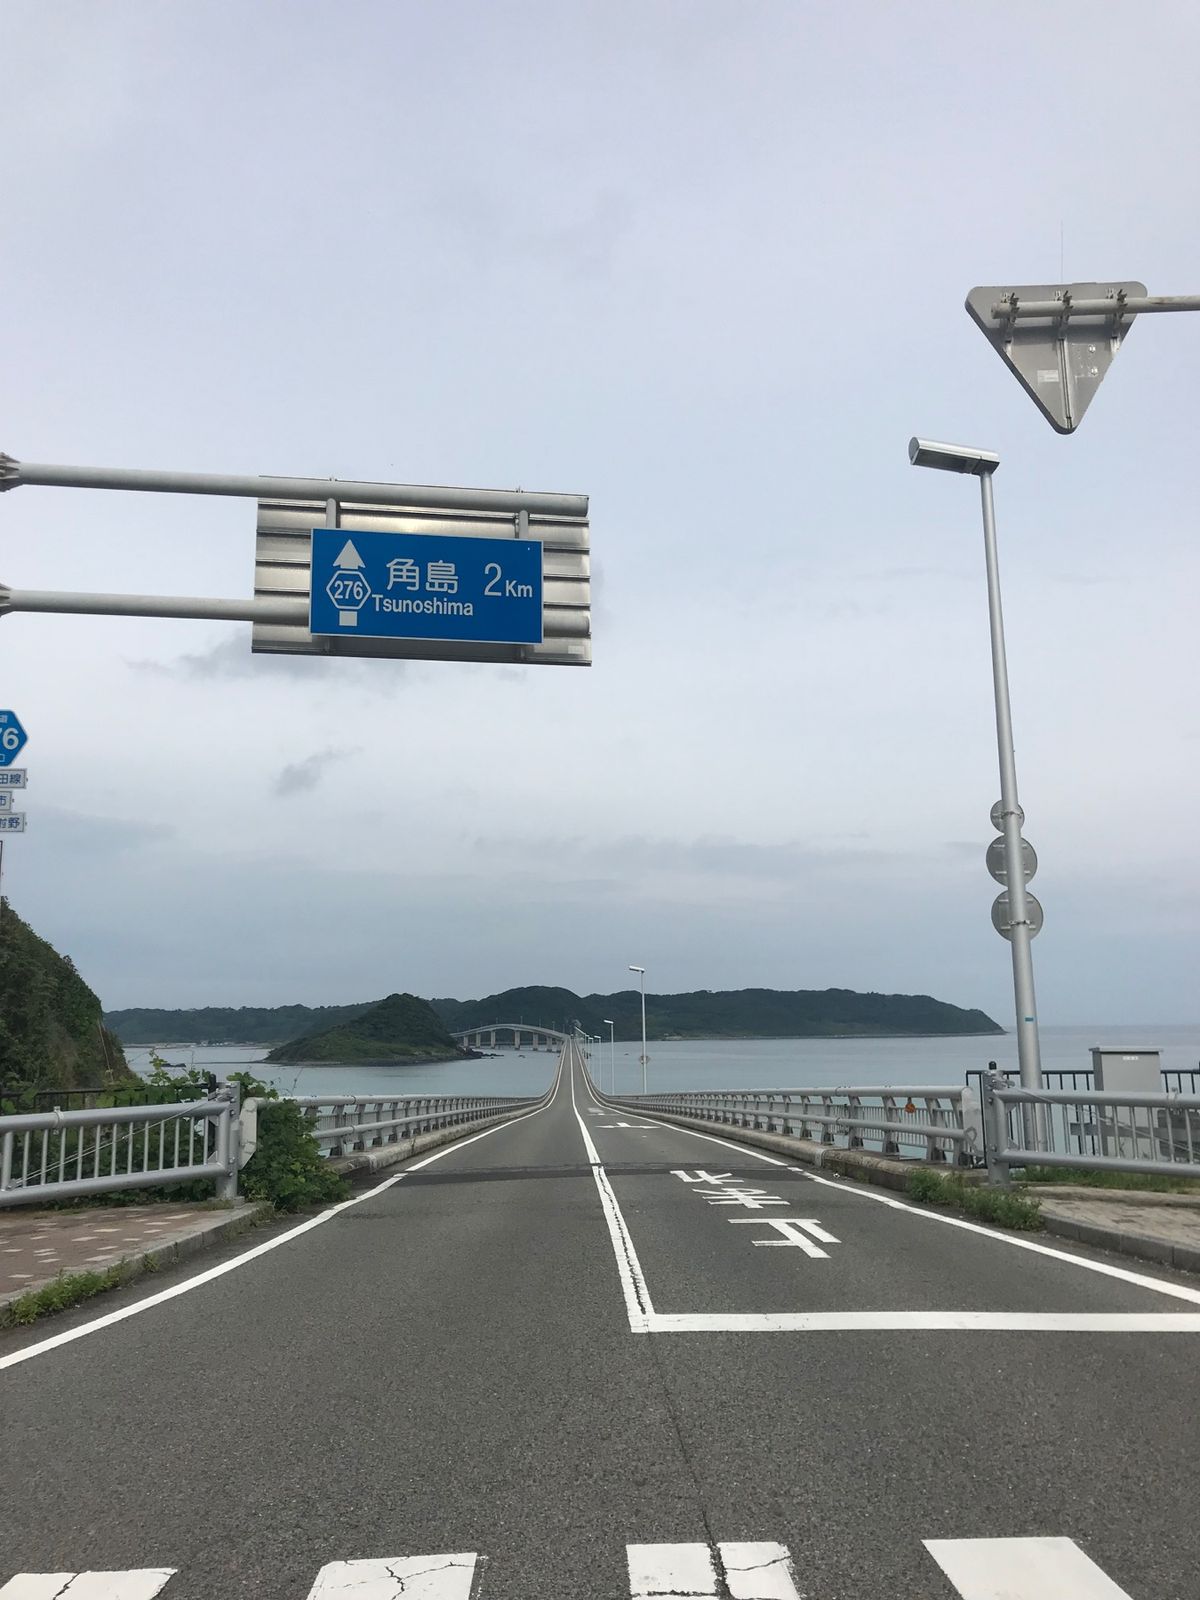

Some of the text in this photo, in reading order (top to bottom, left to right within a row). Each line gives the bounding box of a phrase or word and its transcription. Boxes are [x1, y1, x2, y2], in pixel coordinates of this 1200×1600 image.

[385, 558, 459, 594] 角島
[334, 580, 363, 600] 276
[372, 594, 474, 616] Tsunoshima
[0, 727, 19, 750] 6
